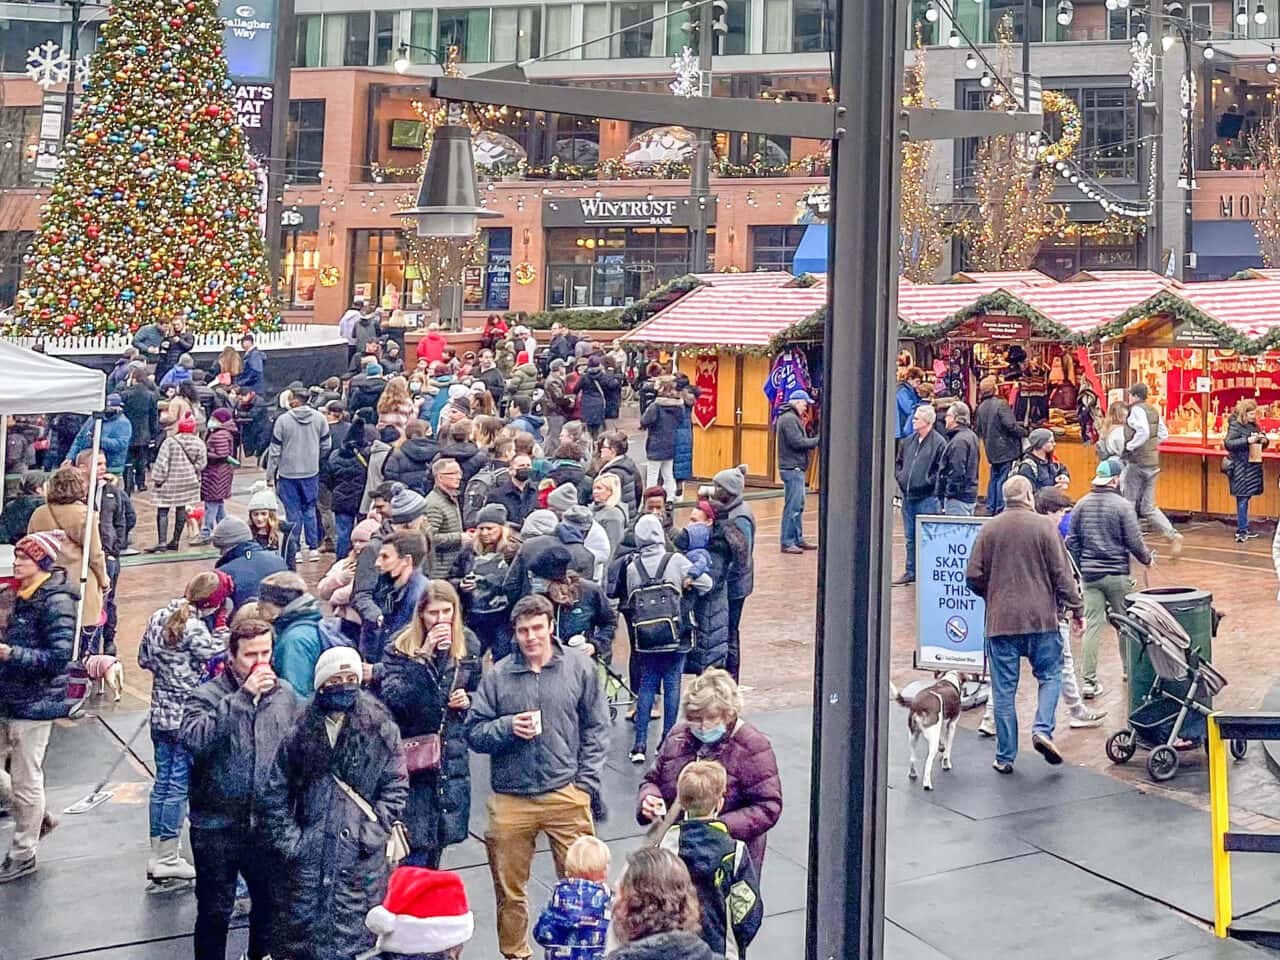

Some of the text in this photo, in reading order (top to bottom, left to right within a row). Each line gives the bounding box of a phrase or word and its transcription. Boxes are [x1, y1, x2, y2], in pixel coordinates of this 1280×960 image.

[232, 28, 256, 39] Way
[579, 198, 673, 216] WINTRUST
[649, 216, 673, 225] BANK
[948, 543, 967, 555] NO
[935, 556, 969, 569] SKAT
[932, 569, 964, 583] BEYO
[943, 583, 971, 597] THIS
[938, 597, 977, 611] POINT
